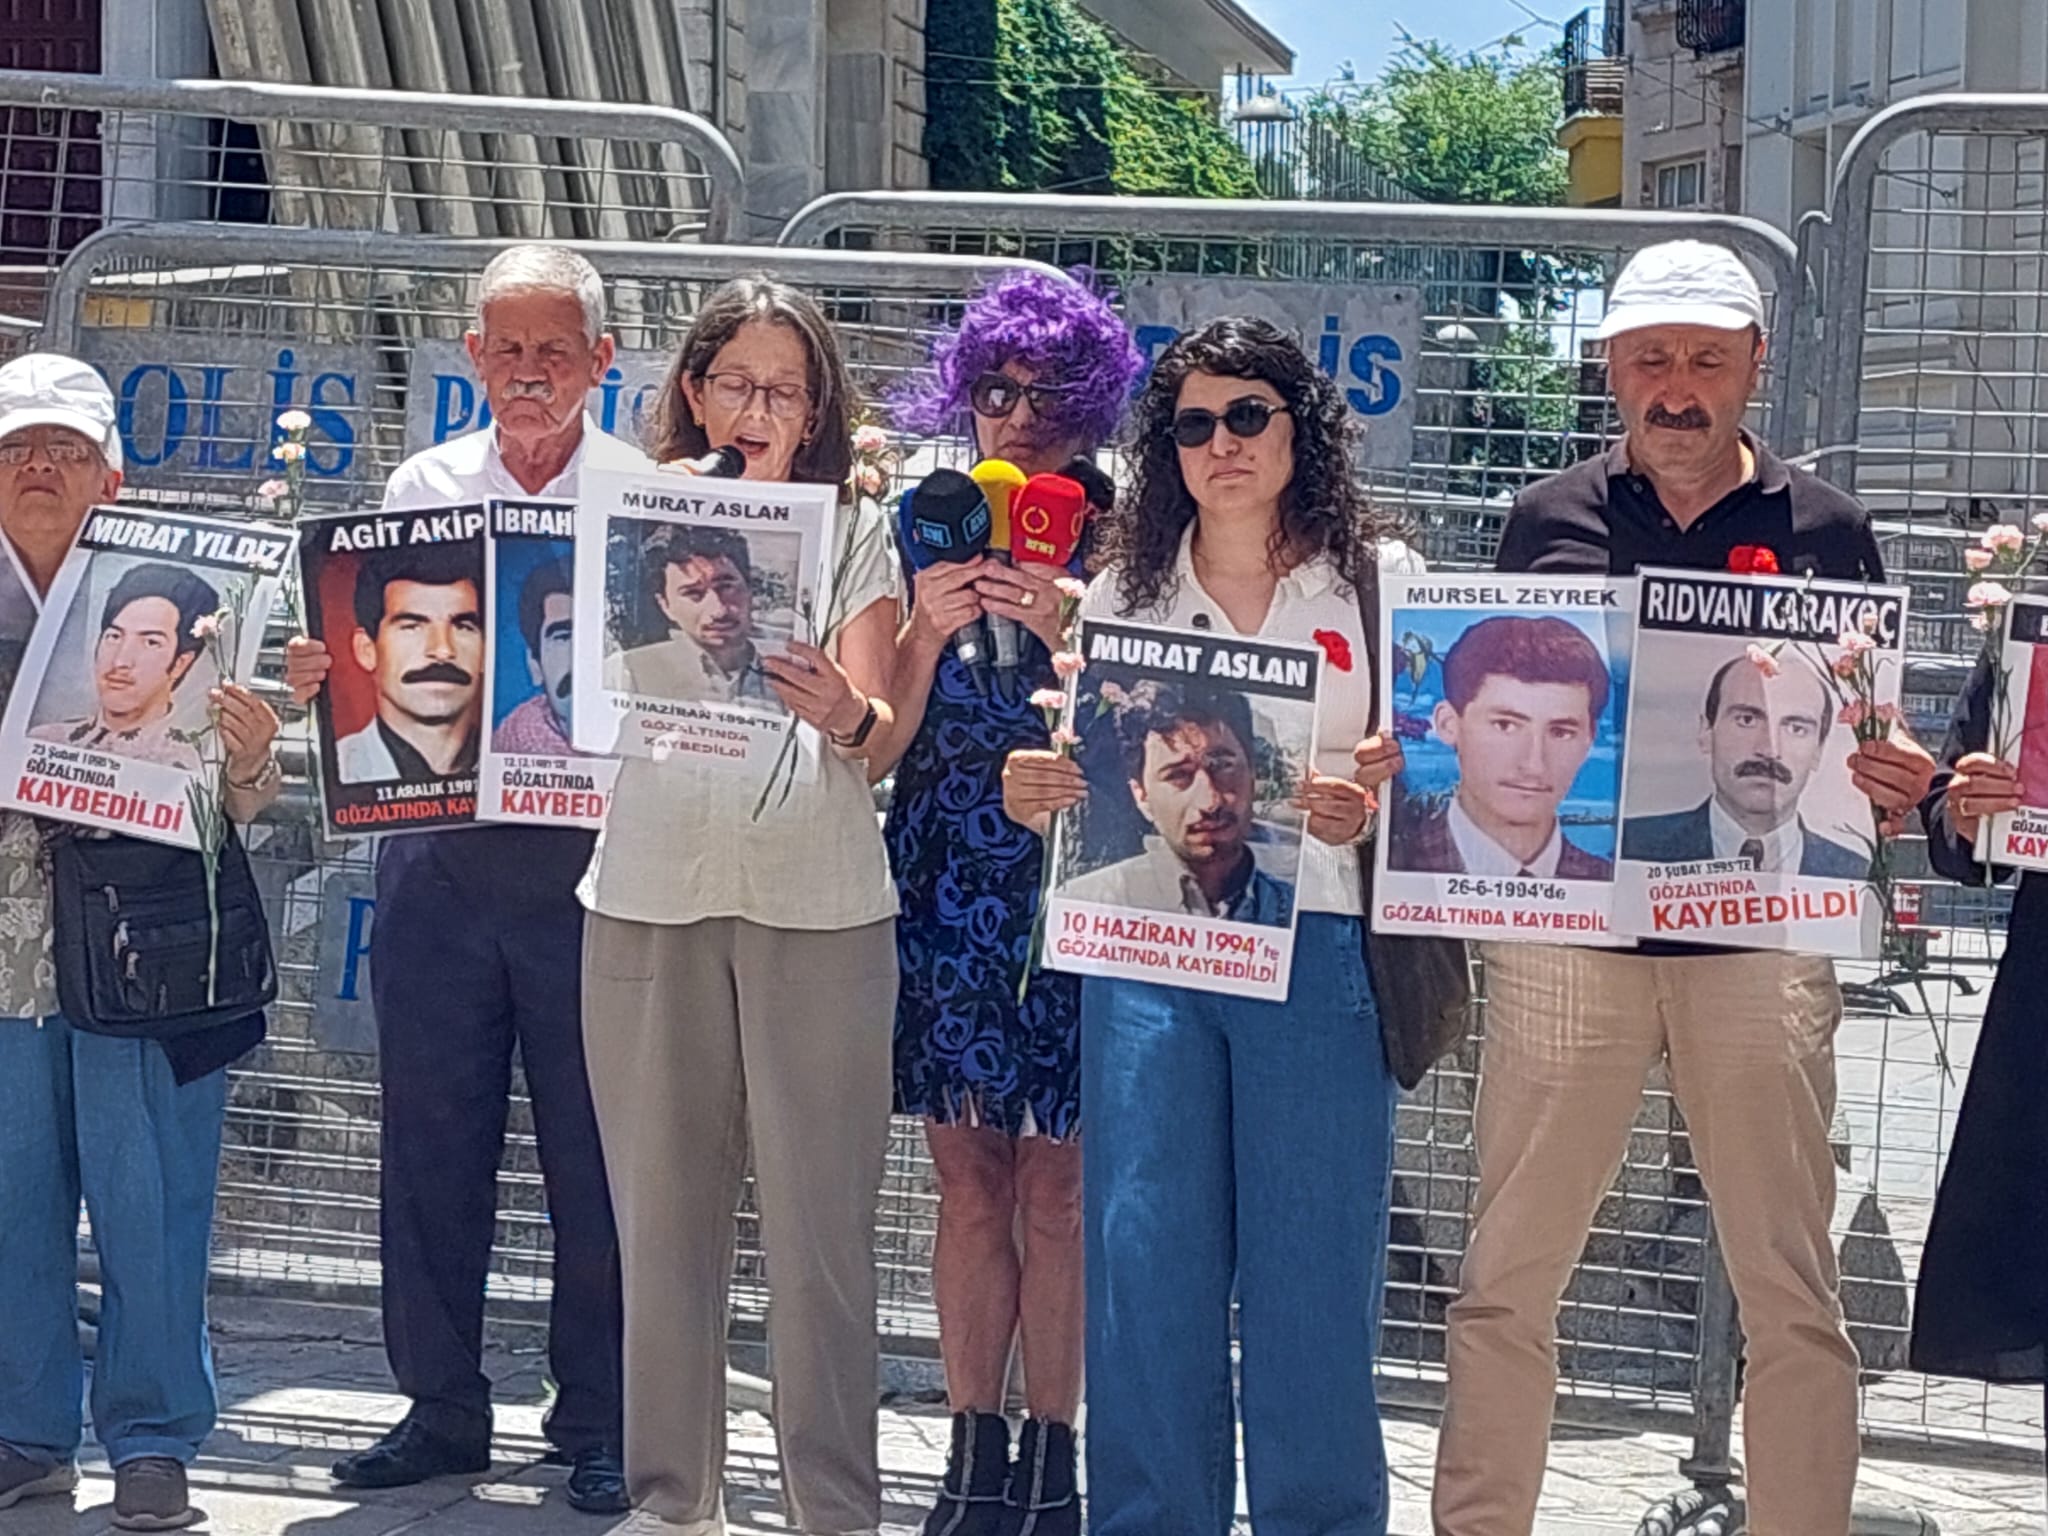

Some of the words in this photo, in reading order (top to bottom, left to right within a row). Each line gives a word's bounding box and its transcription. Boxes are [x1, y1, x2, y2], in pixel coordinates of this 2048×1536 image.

[96, 349, 356, 475] OLİS
[622, 492, 705, 514] MURAT
[711, 501, 790, 521] ASLAN
[84, 514, 190, 553] MURAT
[192, 530, 286, 568] YILDIZ
[330, 517, 404, 552] AGİT
[409, 510, 484, 544] AKİP
[1406, 587, 1509, 605] MURSEL
[1516, 588, 1618, 607] ZEYREK
[1647, 581, 1753, 629] RIDVAN
[1762, 590, 1898, 648] KARAKOÇ
[1090, 633, 1202, 673] MURAT
[1208, 649, 1308, 687] ASLAN
[635, 700, 711, 720] HAZİRAN
[26, 757, 116, 788] GÖZALTINDA
[503, 769, 594, 791] GÖZALTINDA
[16, 777, 185, 832] KAYBEDİLDİ
[396, 782, 445, 799] ARALIK
[335, 801, 443, 825] GÖZALTINDA
[1649, 878, 1756, 901] GÖZALTINDA
[1382, 902, 1506, 926] GÖZALTINDA
[1652, 884, 1858, 931] KAYBEDİLDİ
[1063, 912, 1087, 933] 10
[1093, 915, 1196, 948] HAZİRAN
[1057, 935, 1171, 969] GÖZALTINDA
[1176, 953, 1278, 983] KAYBEDİLDİ
